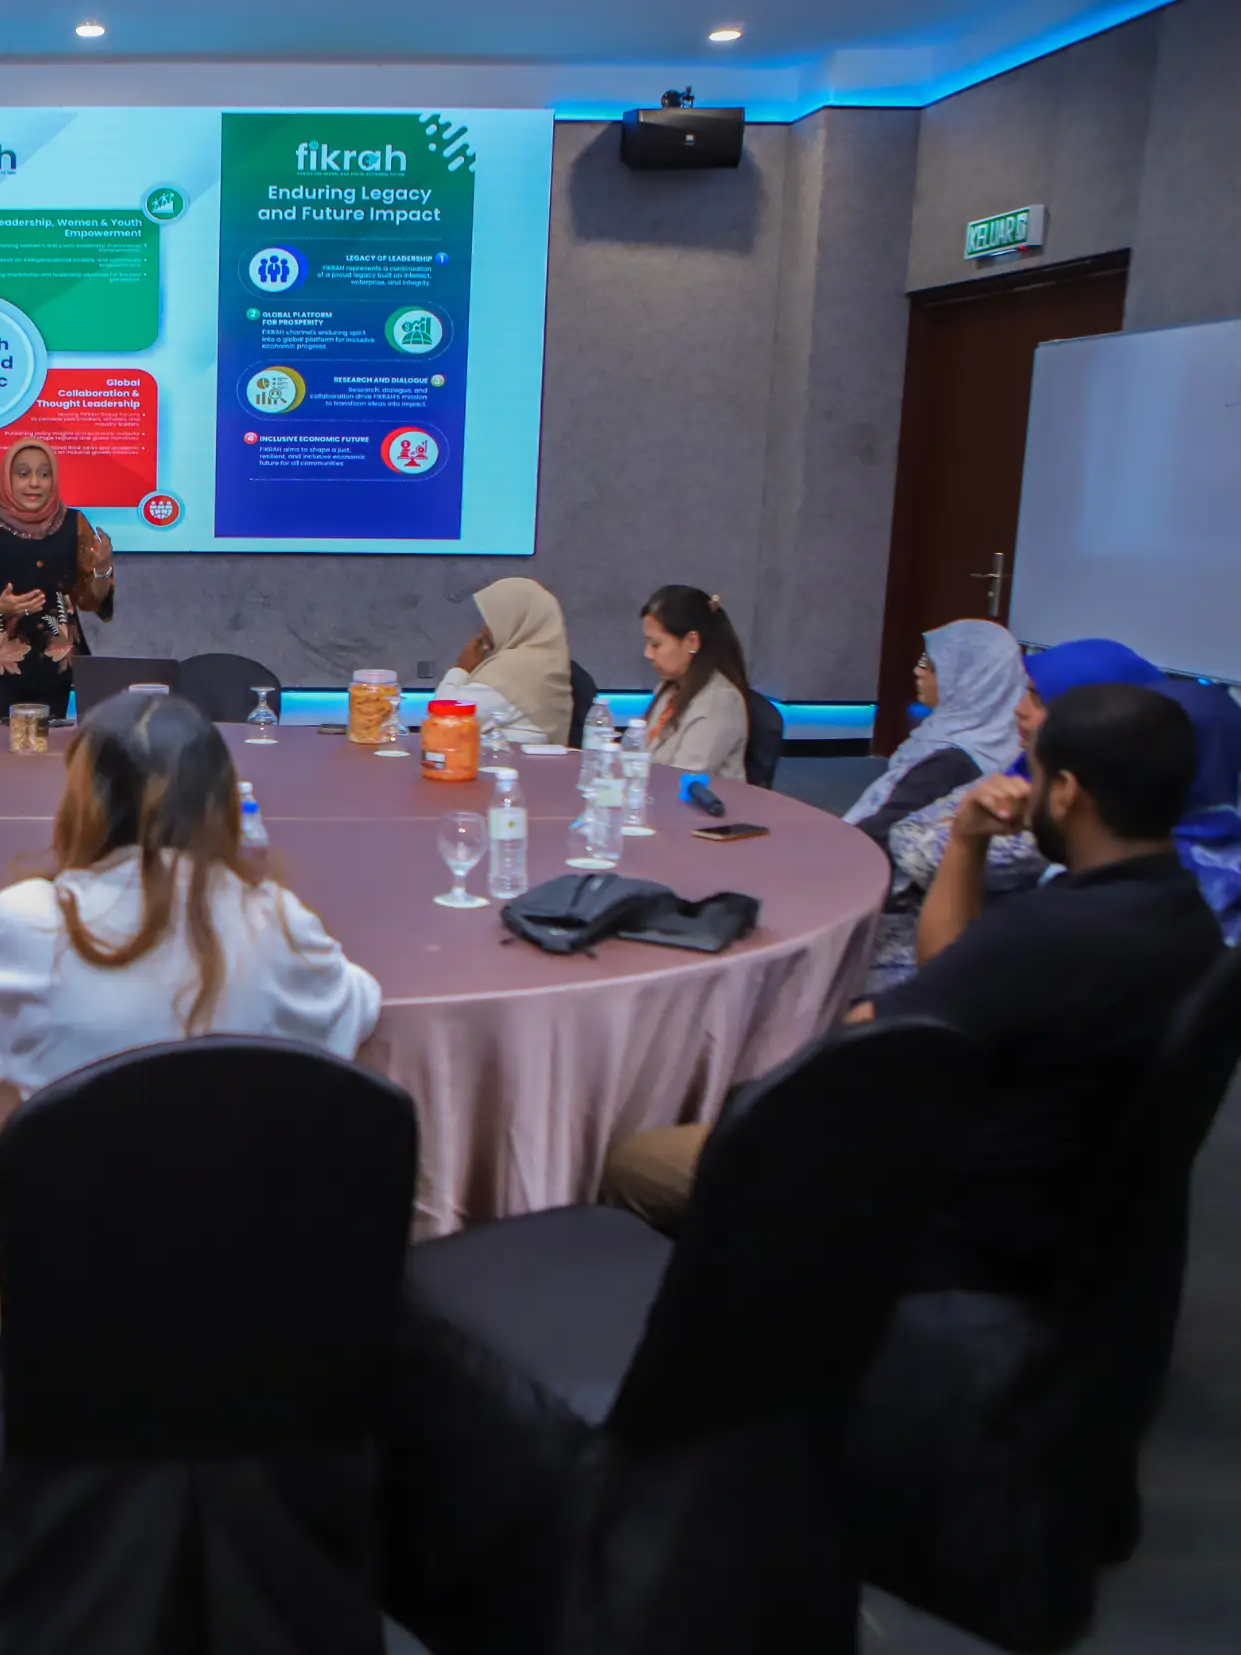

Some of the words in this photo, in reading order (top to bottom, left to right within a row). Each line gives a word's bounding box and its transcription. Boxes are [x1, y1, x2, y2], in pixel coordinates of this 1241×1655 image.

[296, 140, 406, 171] fikrah
[268, 185, 356, 205] Enduring
[362, 185, 432, 205] Legacy
[57, 218, 98, 227] Women
[100, 218, 108, 227] &
[111, 218, 142, 227] Youth
[258, 206, 296, 221] and
[302, 206, 364, 221] Future
[370, 207, 440, 226] Impact
[64, 229, 142, 238] Empowerment
[968, 216, 1015, 252] KELUAR
[37, 400, 80, 409] Thought
[83, 400, 140, 409] Leadership
